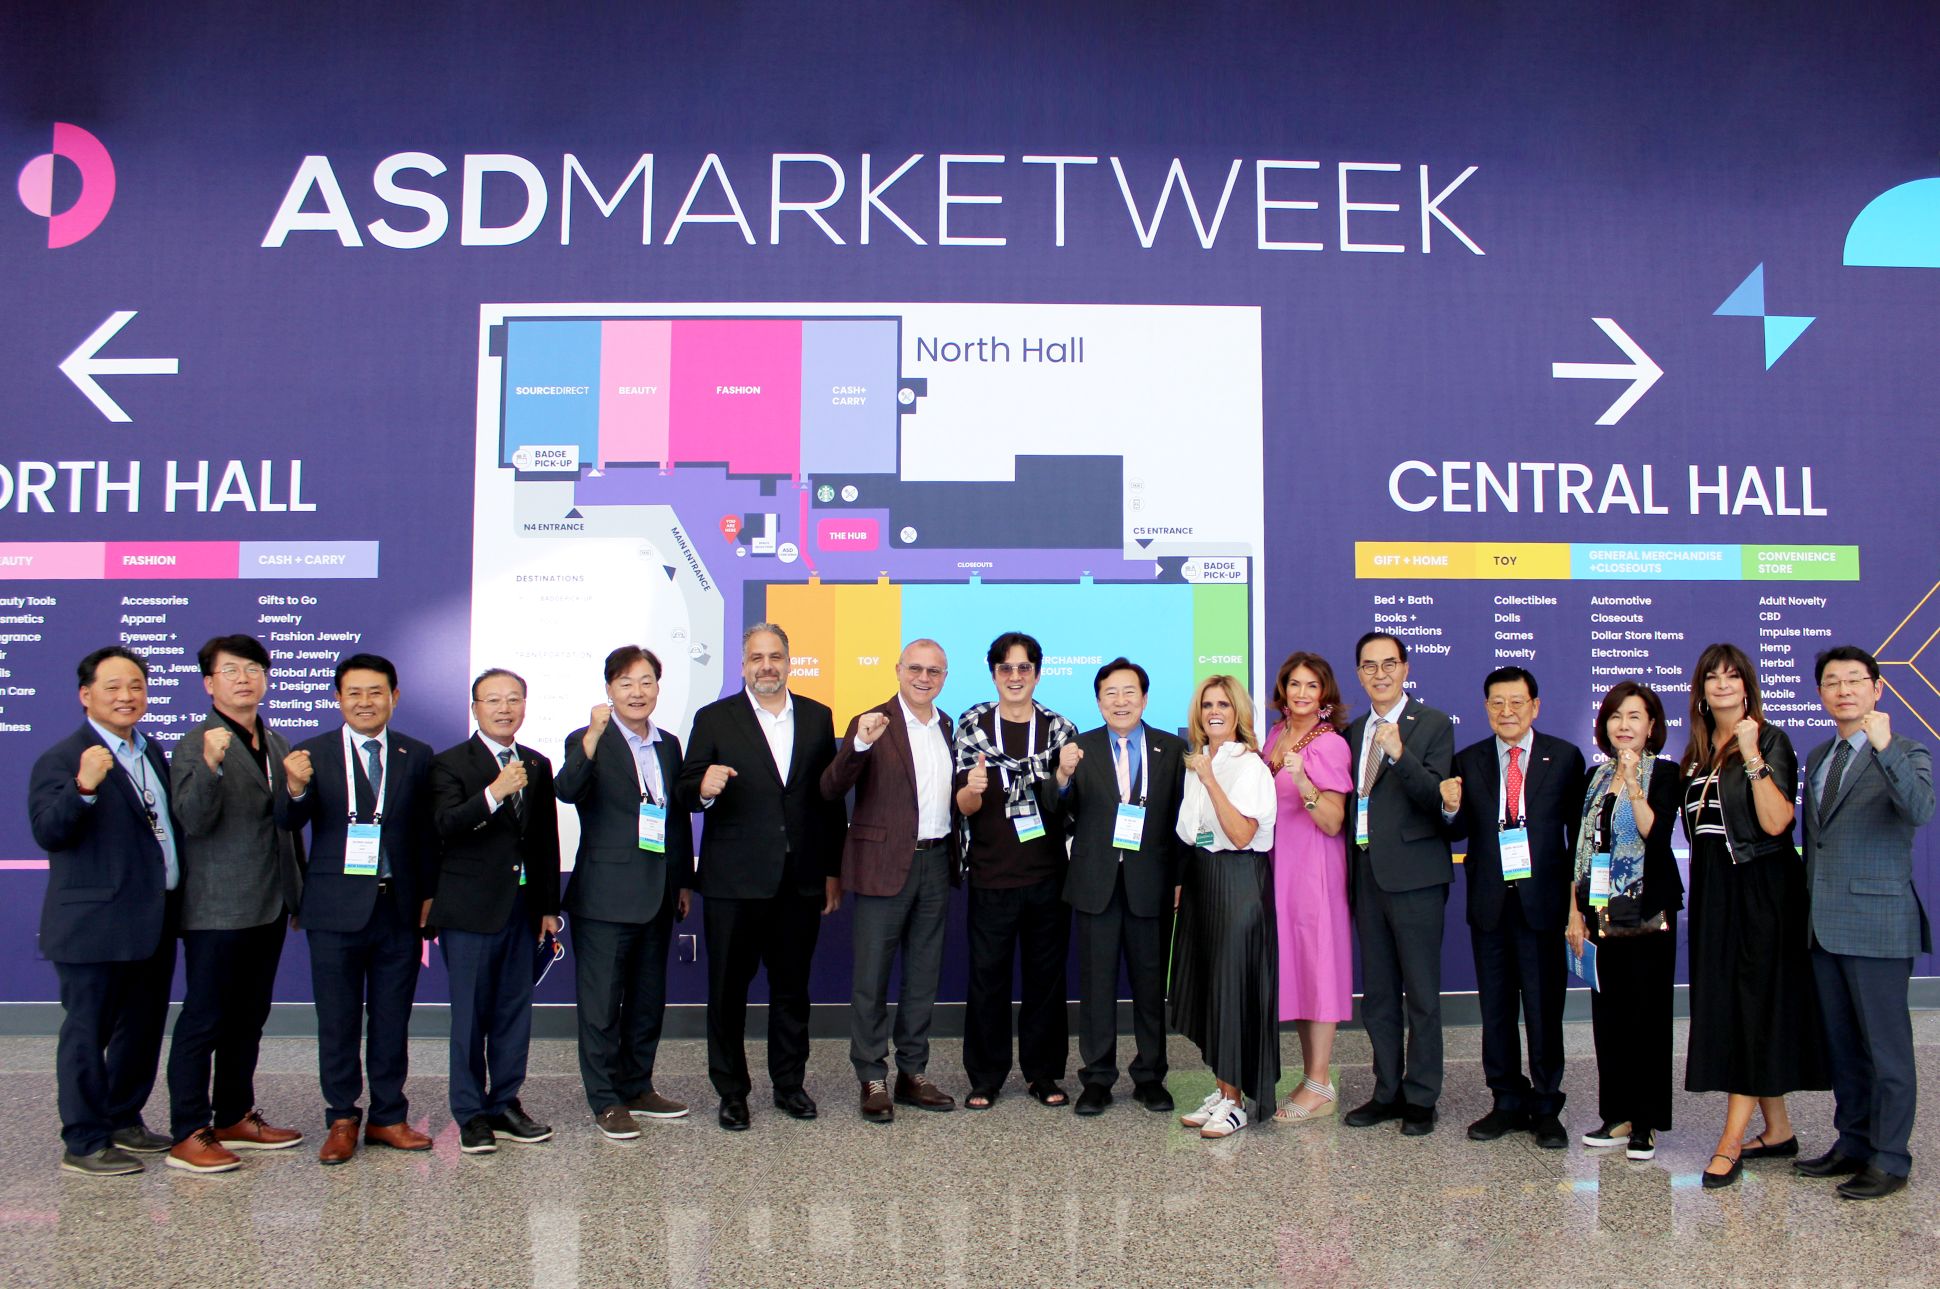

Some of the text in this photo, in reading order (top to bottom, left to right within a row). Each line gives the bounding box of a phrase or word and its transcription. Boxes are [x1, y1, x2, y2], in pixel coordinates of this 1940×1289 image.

[917, 337, 1084, 363] North Hall
[515, 386, 590, 395] SOURCEDIRECT
[618, 386, 657, 395] BEAUTY
[716, 386, 761, 394] FASHION
[832, 397, 866, 406] CARRY
[535, 450, 567, 458] BADGE
[535, 459, 572, 467] PICK-UP
[0, 459, 317, 513] RTH HALL
[1388, 460, 1828, 516] CENTRAL HALL
[524, 523, 585, 531] N4 ENTRANCE
[1133, 527, 1194, 535] C5 ENTRANCE
[829, 531, 867, 540] THE HUB
[122, 555, 176, 566] FASHION
[258, 554, 292, 566] CASH
[304, 554, 346, 566] CARRY
[671, 527, 712, 592] MAIN ENTRANCE
[1374, 555, 1400, 566] GIFT
[1413, 555, 1448, 566] HOME
[1589, 550, 1723, 561] GENERAL MERCHANDISE
[1758, 551, 1836, 562] CONVENIENCE
[0, 556, 33, 567] AUTY
[1203, 562, 1235, 570] BADGE
[1493, 556, 1517, 566] TOY
[1590, 563, 1662, 573] +CLOSEOUTS
[1758, 564, 1793, 574] STORE
[1203, 571, 1241, 579] PICK-UP
[0, 596, 57, 609] auty Tools
[120, 596, 189, 606] Accessories
[258, 595, 317, 606] Gifts to Go
[1374, 595, 1396, 605] Bed
[1407, 595, 1434, 605] Bath
[1493, 595, 1557, 605] Collectibles
[1590, 595, 1652, 606] Automotive
[1758, 596, 1827, 609] Adult Novelty
[0, 614, 45, 624] smetics
[120, 613, 166, 626] Apparel
[258, 613, 302, 626] Jewelry
[1374, 612, 1408, 623] Books
[1494, 613, 1521, 623] Dolls
[1590, 613, 1644, 623] Closeouts
[1759, 612, 1781, 621] CBD
[120, 632, 168, 644] Eyewear
[270, 631, 315, 641] Fashion
[316, 631, 361, 644] Jewelry
[1494, 630, 1534, 640] Games
[1591, 630, 1684, 640] Dollar Store Items
[1759, 627, 1832, 639] Impulse Items
[0, 633, 42, 644] grance
[121, 645, 185, 657] nglasses
[1415, 643, 1451, 656] Hobby
[1591, 647, 1649, 658] Electronics
[1760, 643, 1791, 654] Hemp
[270, 649, 341, 662] Fine Jewelry
[1198, 655, 1243, 664] C-STORE
[1494, 648, 1536, 661] Novelty
[858, 656, 880, 666] TOY
[1041, 656, 1103, 665] ERCHANDISE
[1760, 658, 1795, 668] Herbal
[168, 663, 202, 673] Jewel
[269, 667, 336, 678] Global Artis
[789, 668, 820, 677] HOME
[1040, 667, 1073, 676] EOUTS
[1591, 665, 1644, 675] Hardware
[1655, 665, 1683, 675] Tools
[147, 676, 180, 686] tches
[1760, 674, 1801, 686] Lighters
[7, 686, 36, 696] Care
[279, 681, 331, 694] Designer
[1761, 689, 1796, 699] Mobile
[268, 699, 313, 712] Sterling
[314, 699, 341, 709] Silve
[1761, 702, 1822, 711] Accessories
[0, 722, 32, 732] llness
[268, 717, 319, 728] Watches
[1787, 718, 1801, 727] the
[1806, 718, 1838, 727] Coun
